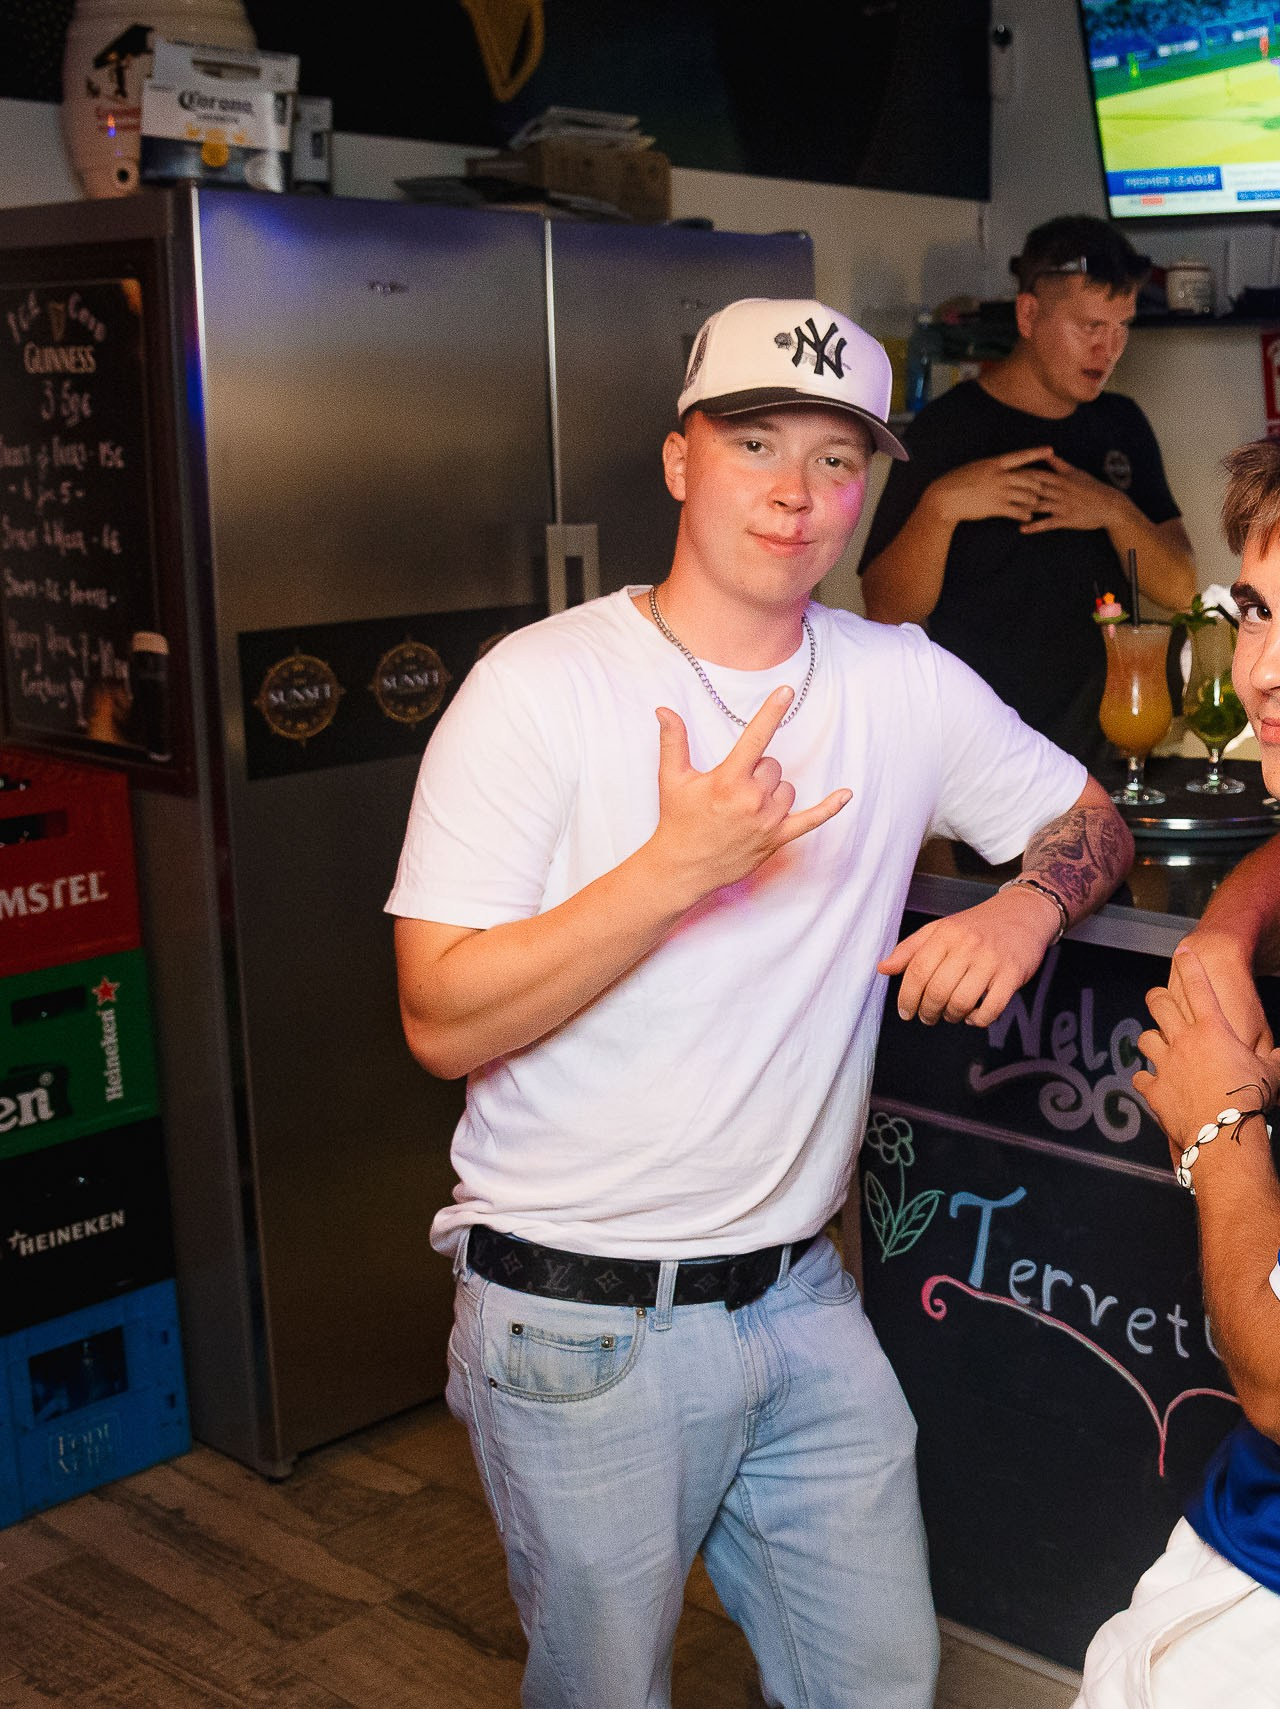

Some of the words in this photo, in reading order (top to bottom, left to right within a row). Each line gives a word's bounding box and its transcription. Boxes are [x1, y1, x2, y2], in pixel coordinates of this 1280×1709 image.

[24, 341, 97, 374] GUINNESS
[986, 944, 1157, 1073] Welc
[100, 1008, 124, 1101] Heineken
[19, 1208, 125, 1257] HEINEKEN
